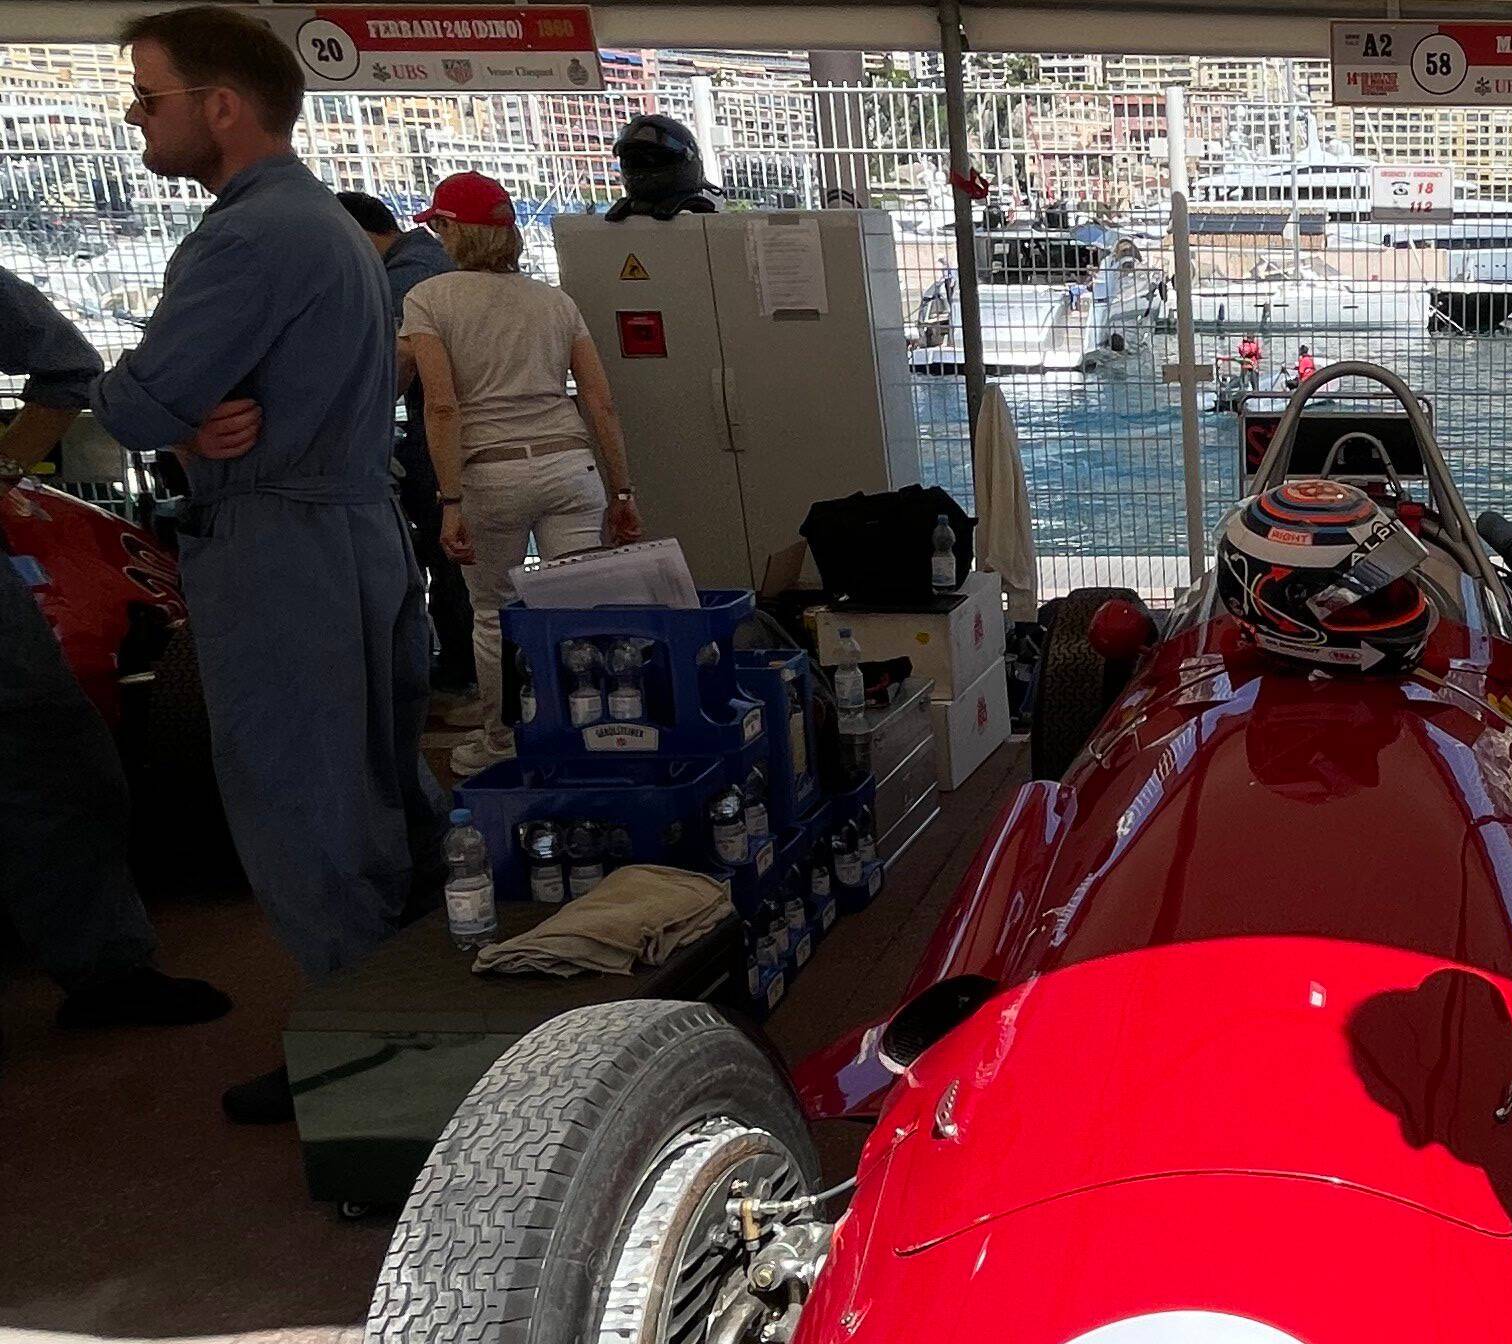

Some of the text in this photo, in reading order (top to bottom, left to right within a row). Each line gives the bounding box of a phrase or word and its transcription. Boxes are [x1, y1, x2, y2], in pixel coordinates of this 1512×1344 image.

[366, 19, 523, 41] FERRARI 246 (DINO)
[311, 38, 344, 62] 20
[1363, 33, 1393, 57] A2
[391, 64, 428, 80] UBS
[1425, 52, 1452, 76] 58
[1418, 182, 1434, 194] 18
[1409, 201, 1433, 213] 112
